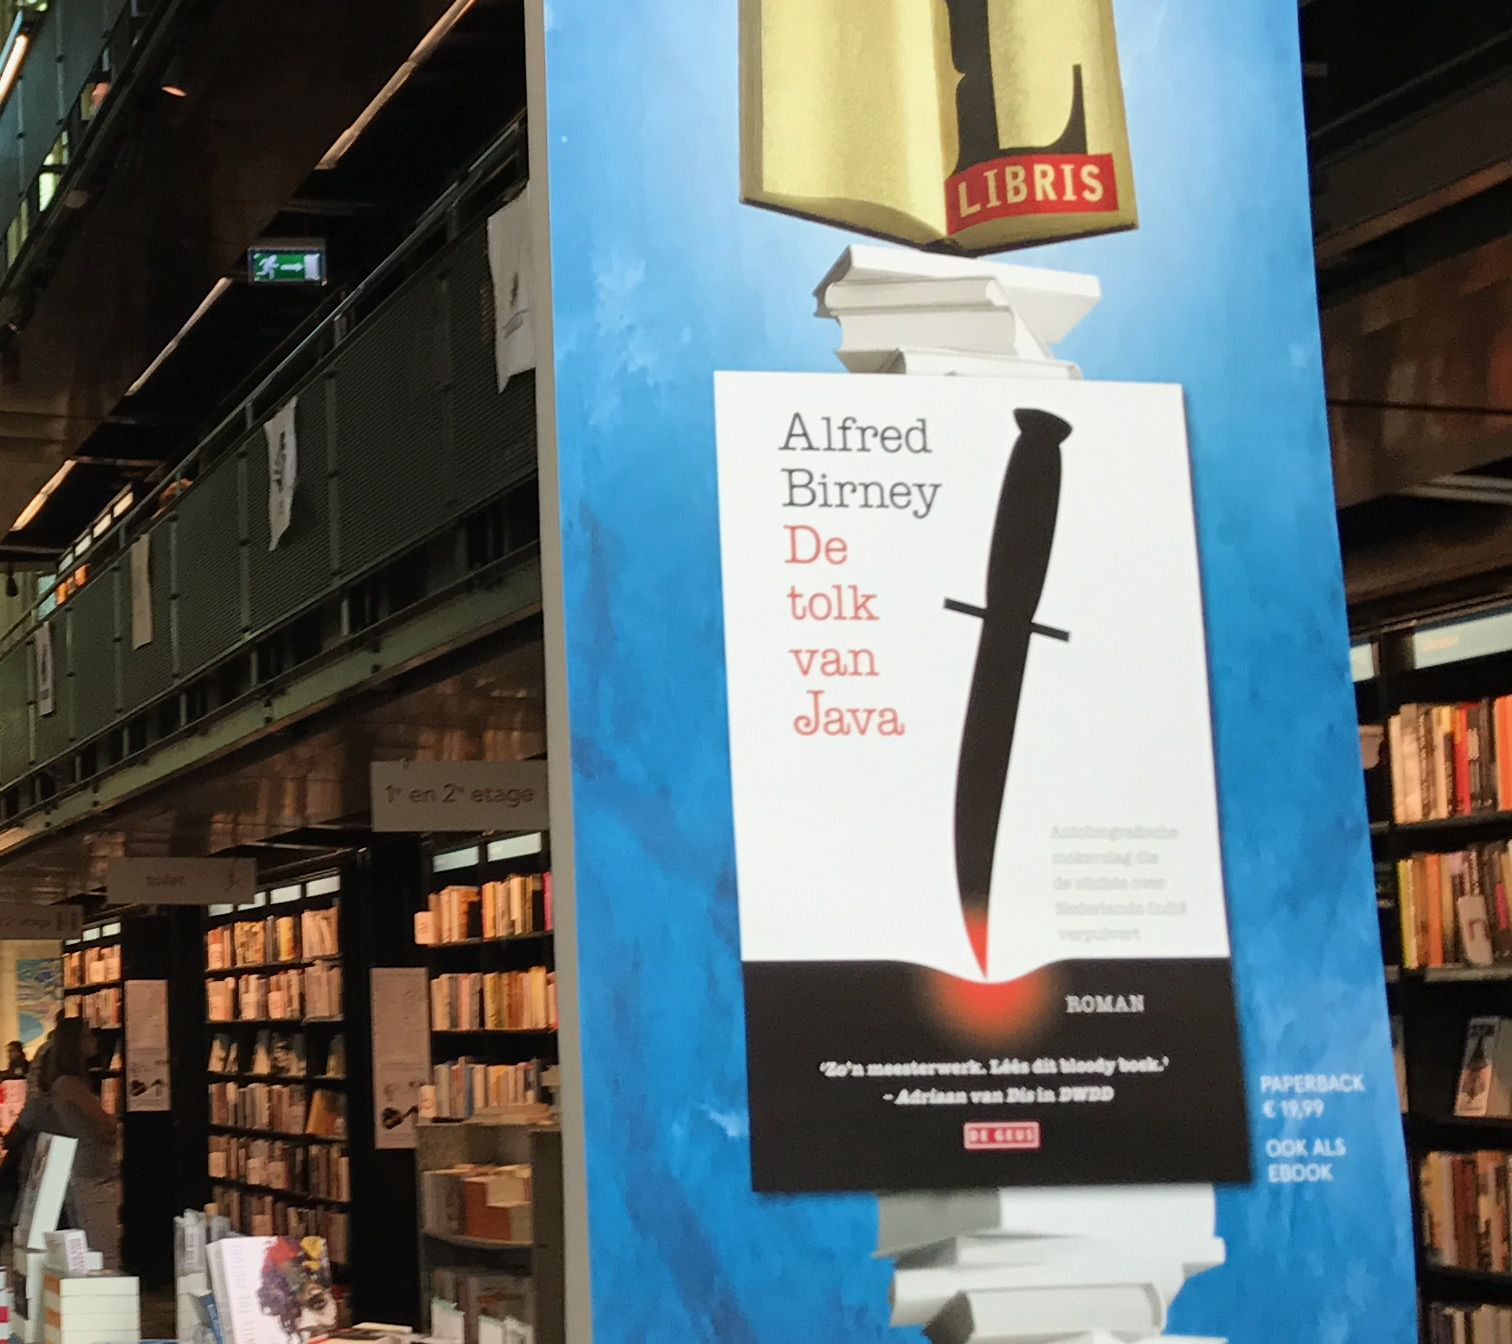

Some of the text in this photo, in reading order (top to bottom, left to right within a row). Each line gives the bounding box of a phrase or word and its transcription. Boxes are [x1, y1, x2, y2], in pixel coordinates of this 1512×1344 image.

[958, 163, 1105, 219] LIBRIS
[778, 412, 933, 455] Alfred
[781, 468, 943, 519] Birney
[783, 524, 849, 565] De
[788, 583, 879, 622] tolk
[790, 644, 879, 679] van
[792, 690, 906, 737] Java
[1065, 994, 1145, 1015] ROMAN
[1032, 1057, 1057, 1074] dit
[1059, 1056, 1116, 1076] bloody
[894, 1087, 968, 1106] Adriaan
[970, 1089, 1004, 1105] van
[1006, 1086, 1036, 1104] Dis
[1036, 1087, 1056, 1103] in
[1260, 1072, 1366, 1095] PAPERBACK
[1281, 1098, 1325, 1120] 19,99
[1265, 1136, 1346, 1159] OOK ALS
[1267, 1160, 1333, 1182] EBOOK
